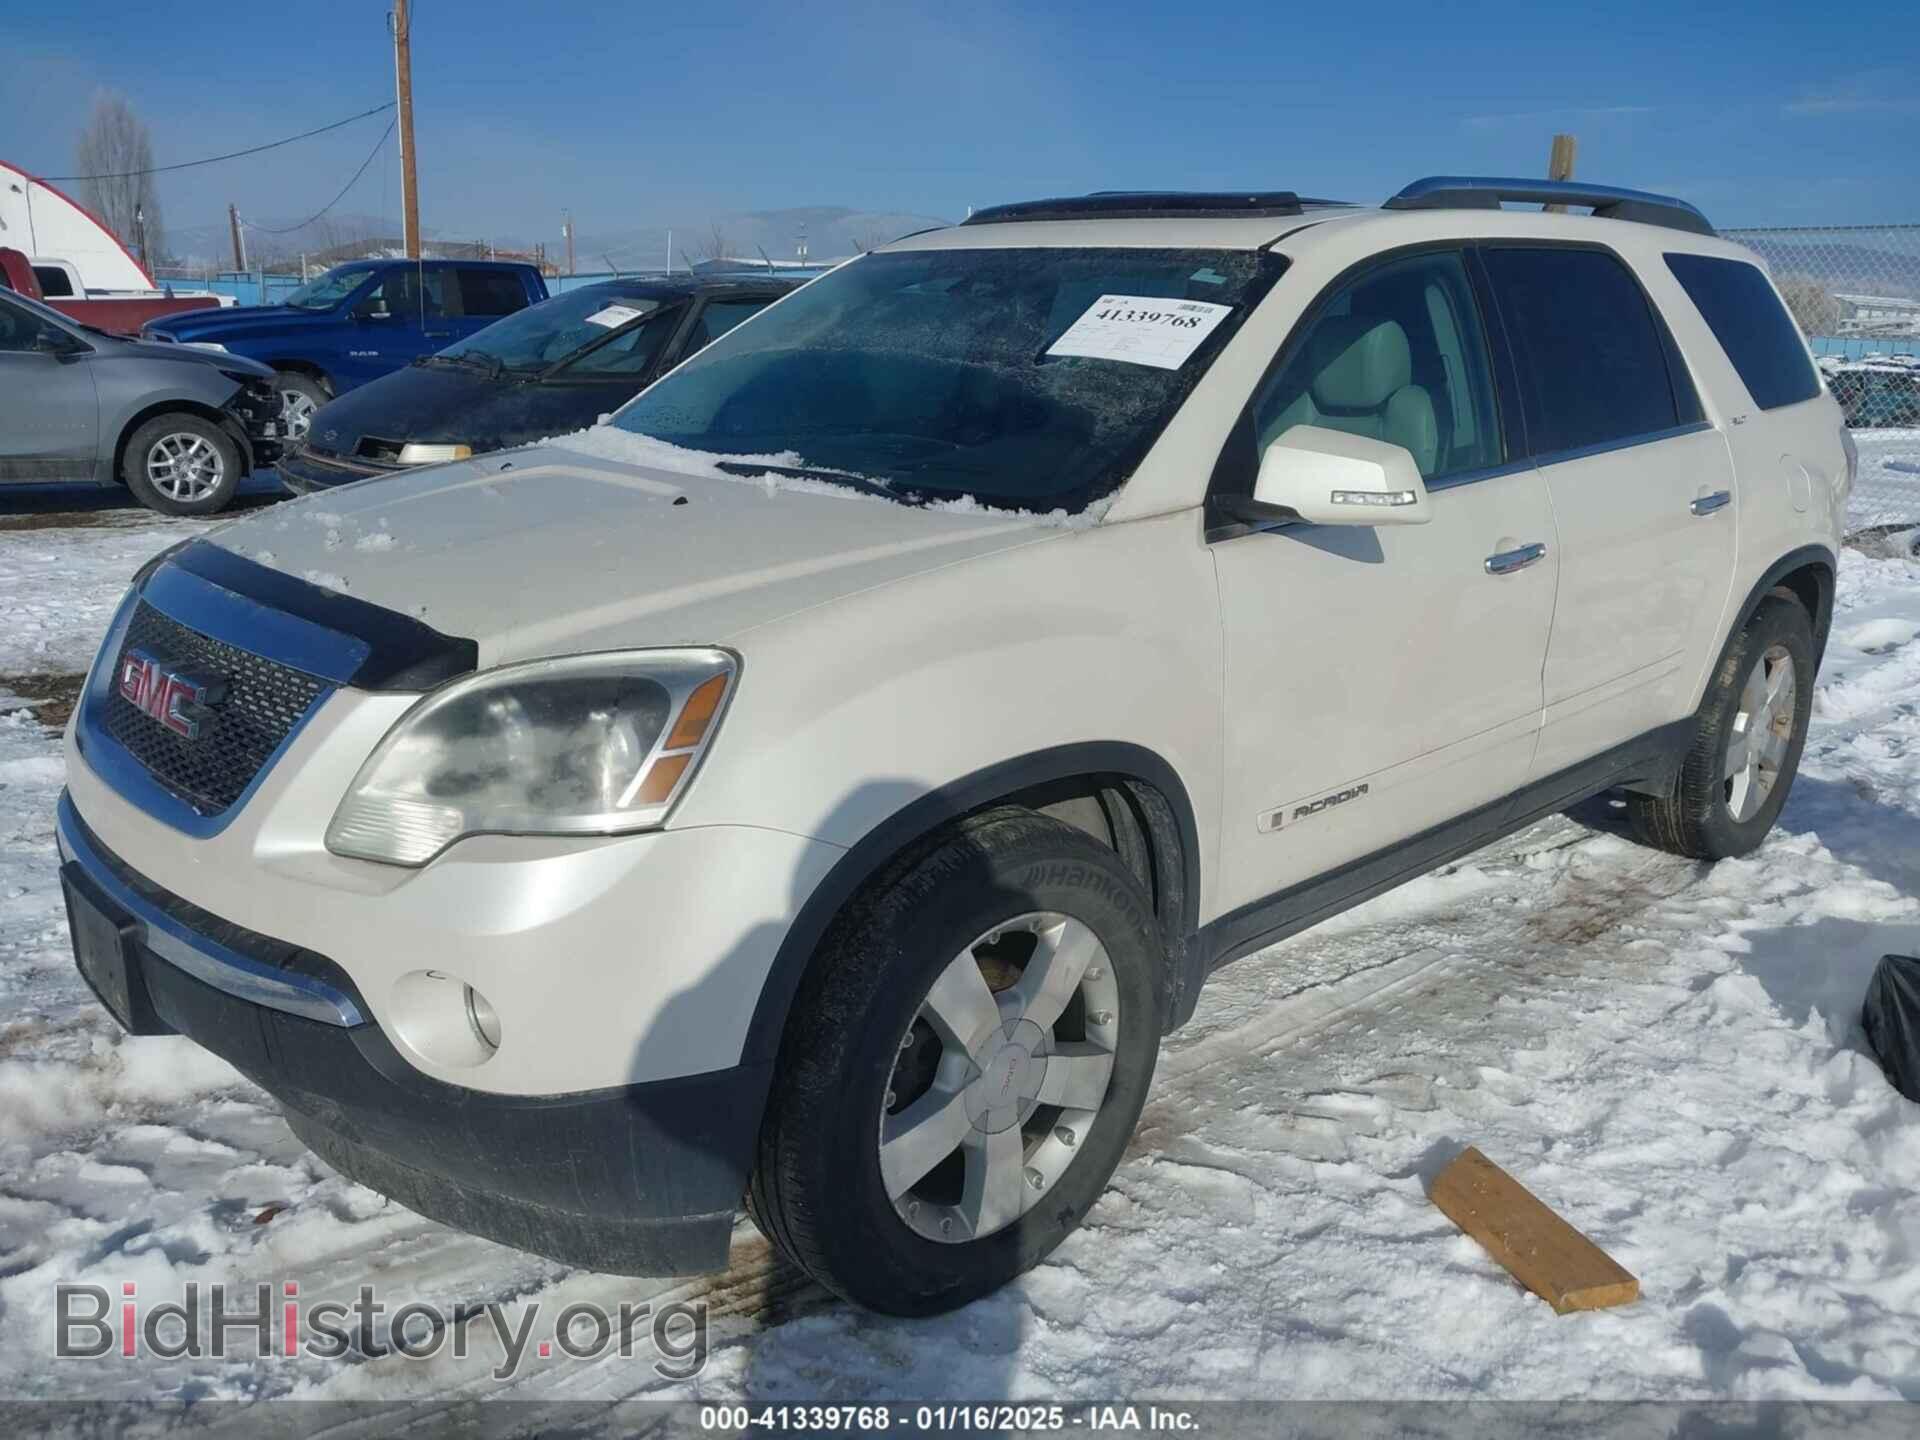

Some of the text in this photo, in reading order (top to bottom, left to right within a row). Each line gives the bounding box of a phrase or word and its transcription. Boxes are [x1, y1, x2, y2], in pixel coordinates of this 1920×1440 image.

[1095, 308, 1202, 330] 41339768
[119, 649, 207, 739] GMC
[1292, 783, 1369, 820] ACADIA
